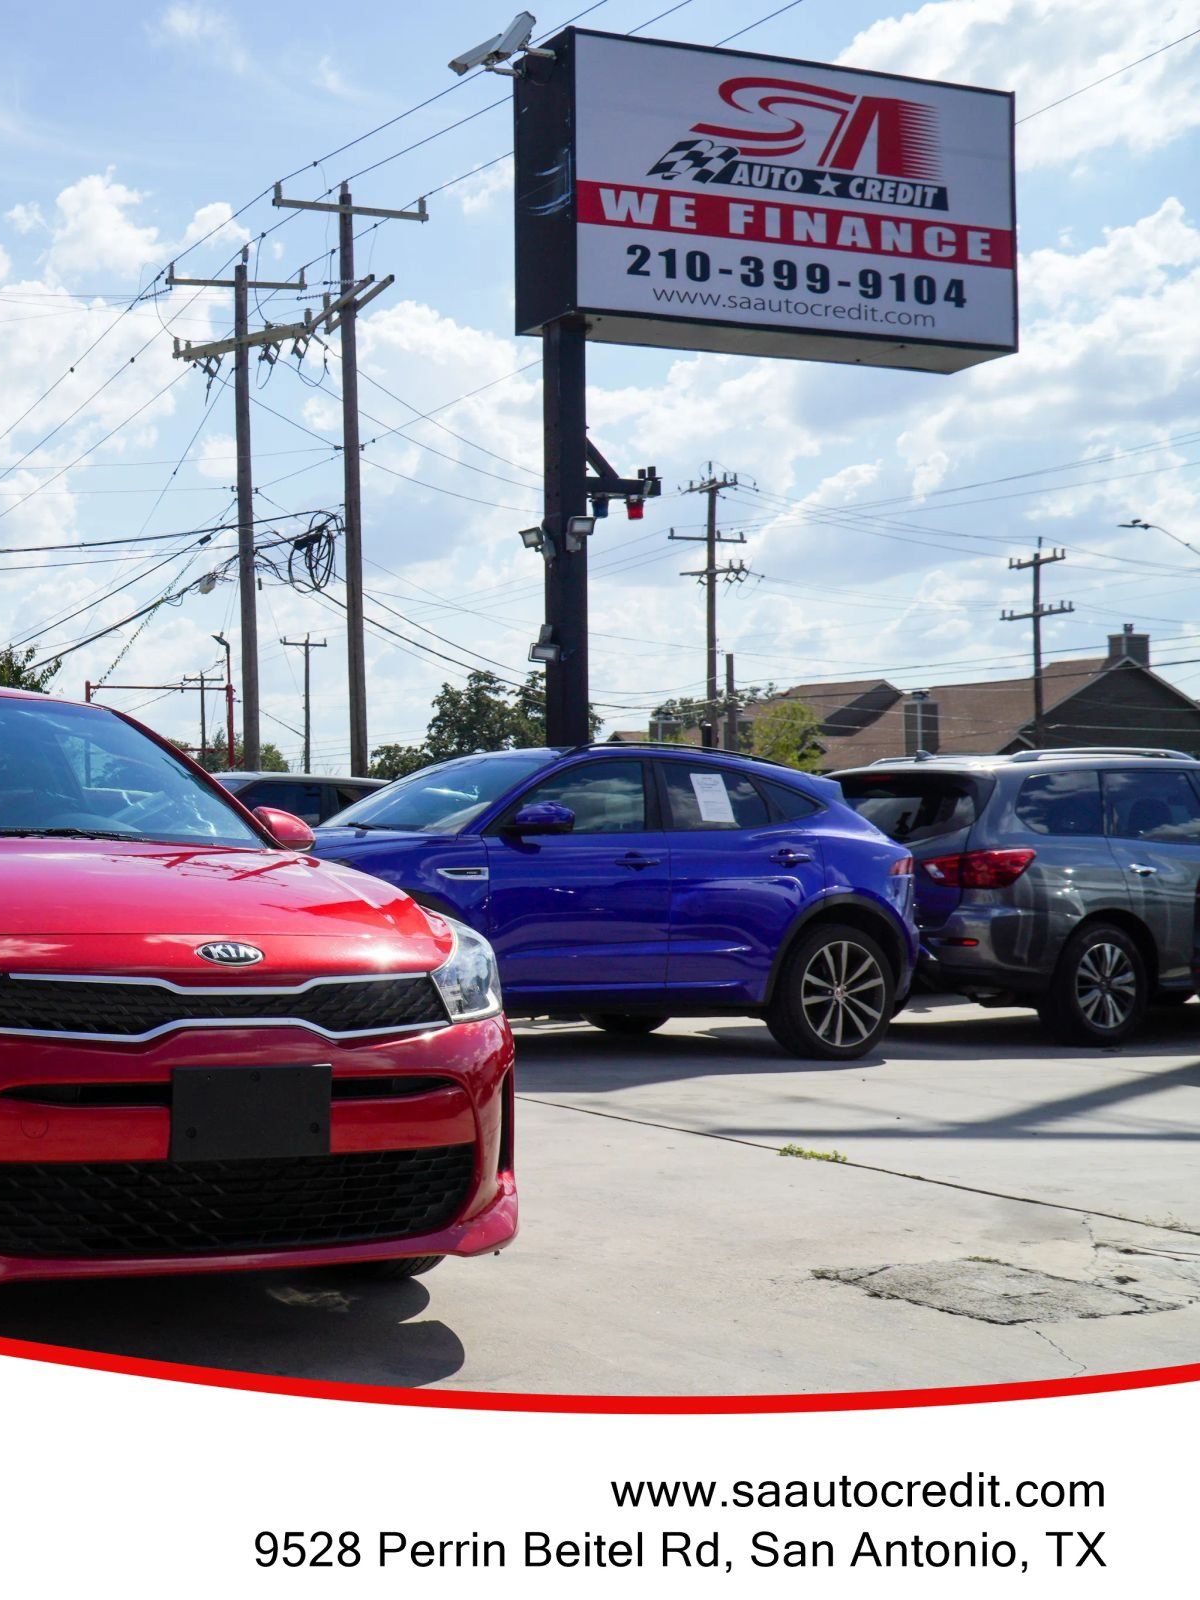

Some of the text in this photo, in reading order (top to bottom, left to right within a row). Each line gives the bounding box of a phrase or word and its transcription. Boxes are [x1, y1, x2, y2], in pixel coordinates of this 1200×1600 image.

[729, 163, 939, 208] AUTO CREDIT
[599, 188, 993, 263] WE FINANCE
[625, 243, 968, 309] 210-399-9104
[652, 286, 936, 328] www.saautocredit.com
[207, 943, 256, 959] KIA
